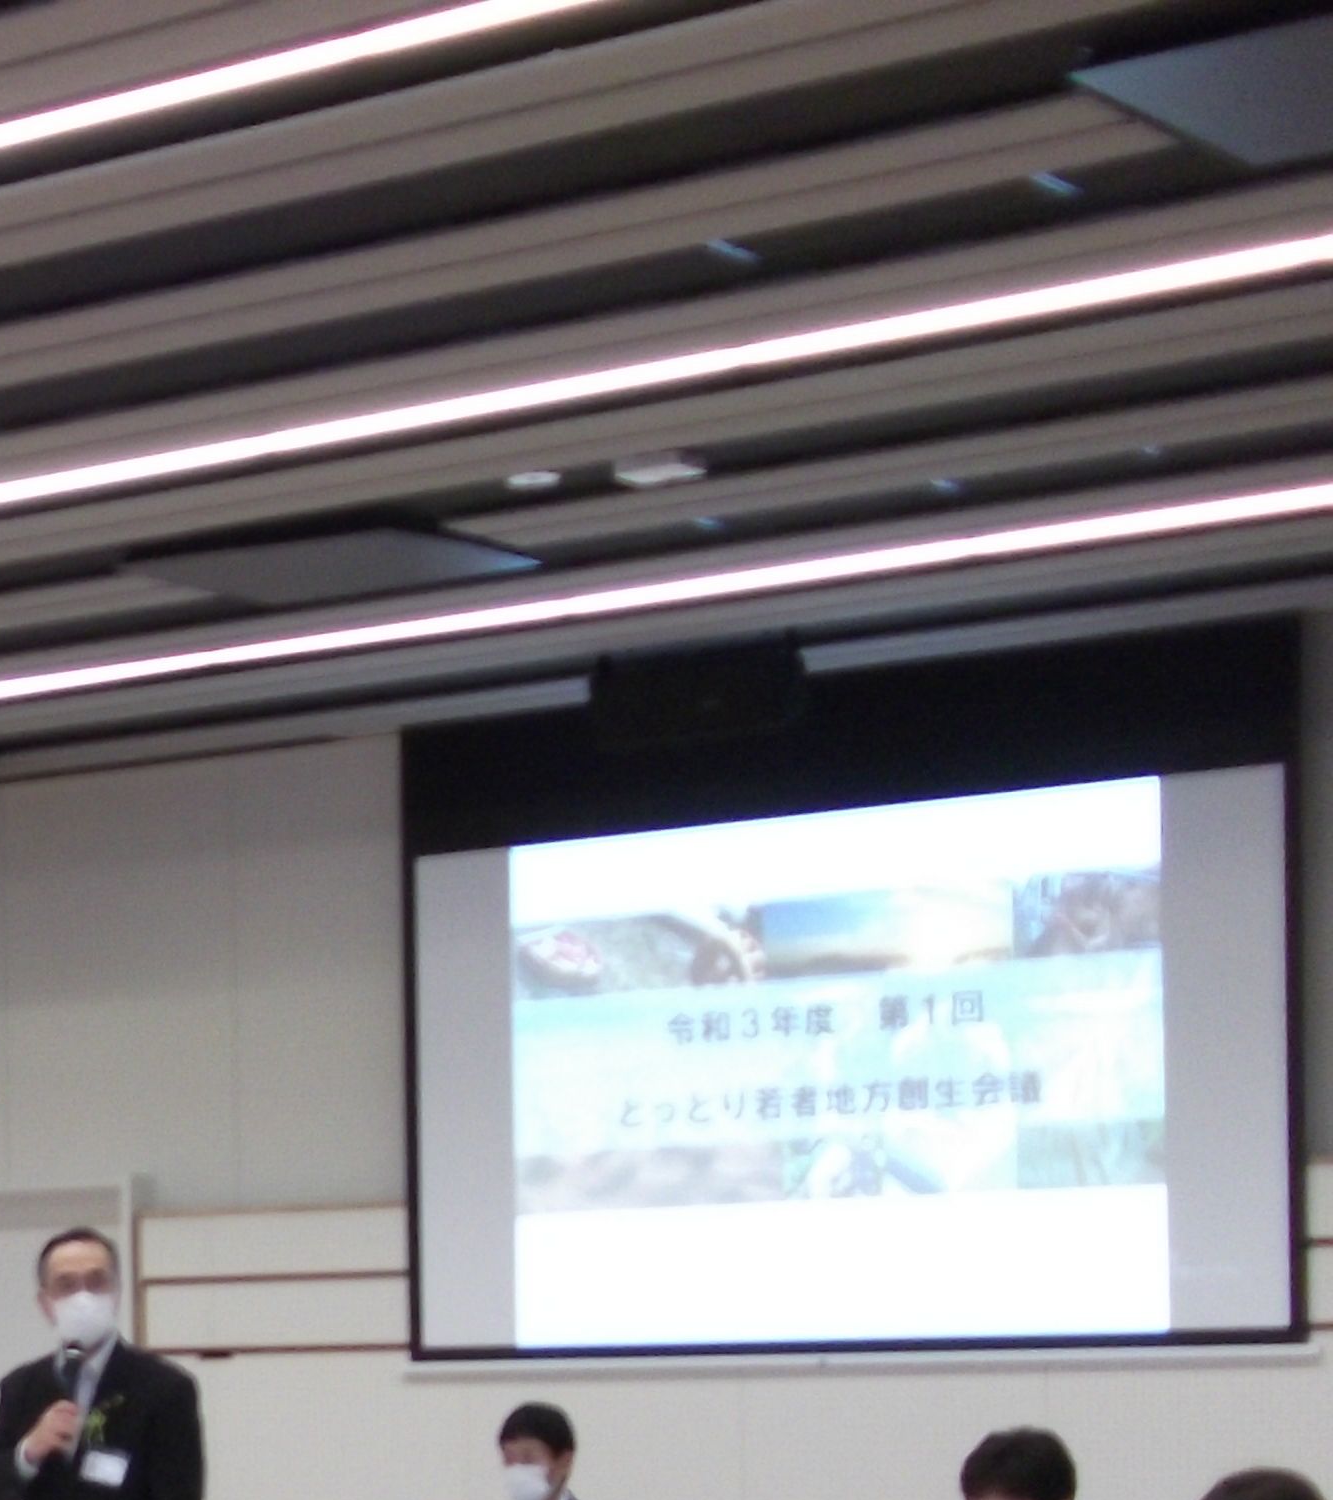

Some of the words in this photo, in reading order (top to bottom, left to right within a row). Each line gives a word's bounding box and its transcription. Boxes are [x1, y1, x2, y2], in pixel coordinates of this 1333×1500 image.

[620, 1070, 1042, 1128] とっとり若者地方創生会議
